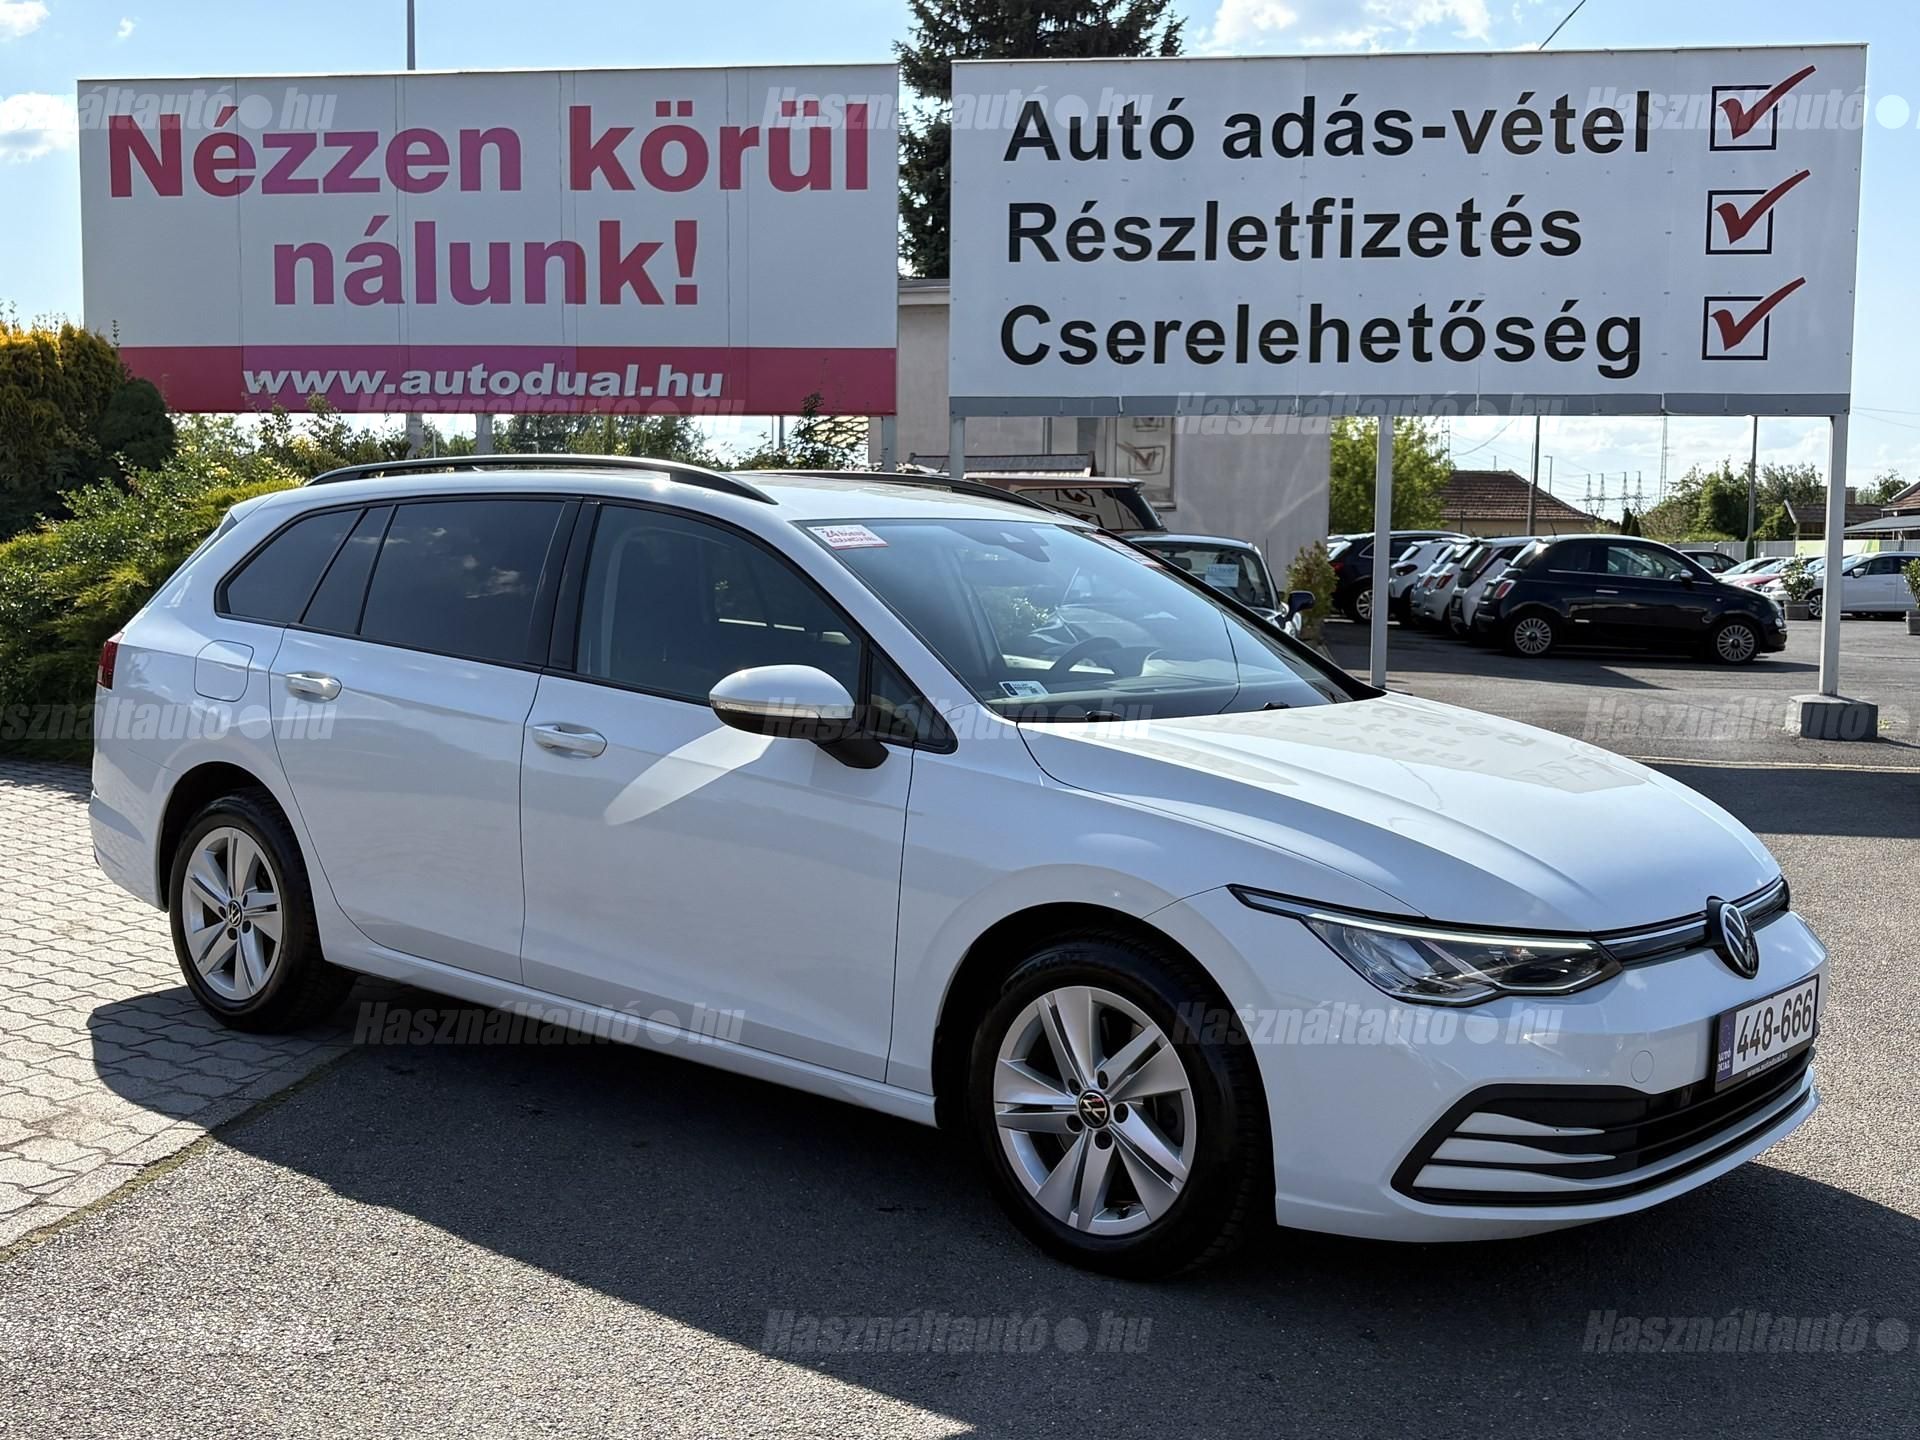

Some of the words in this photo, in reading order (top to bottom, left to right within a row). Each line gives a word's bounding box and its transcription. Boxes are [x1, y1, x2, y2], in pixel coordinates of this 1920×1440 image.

[110, 106, 521, 197] Nézzen
[569, 100, 868, 191] körül
[1003, 97, 1195, 162] Autó
[1222, 90, 1650, 160] adás-vétel
[274, 215, 699, 305] nálunk!
[1008, 193, 1582, 263] Részletfizetés
[1000, 299, 1641, 378] Cserelehetőség
[243, 363, 723, 397] www.autodual.hu
[1735, 988, 1814, 1063] 448-666
